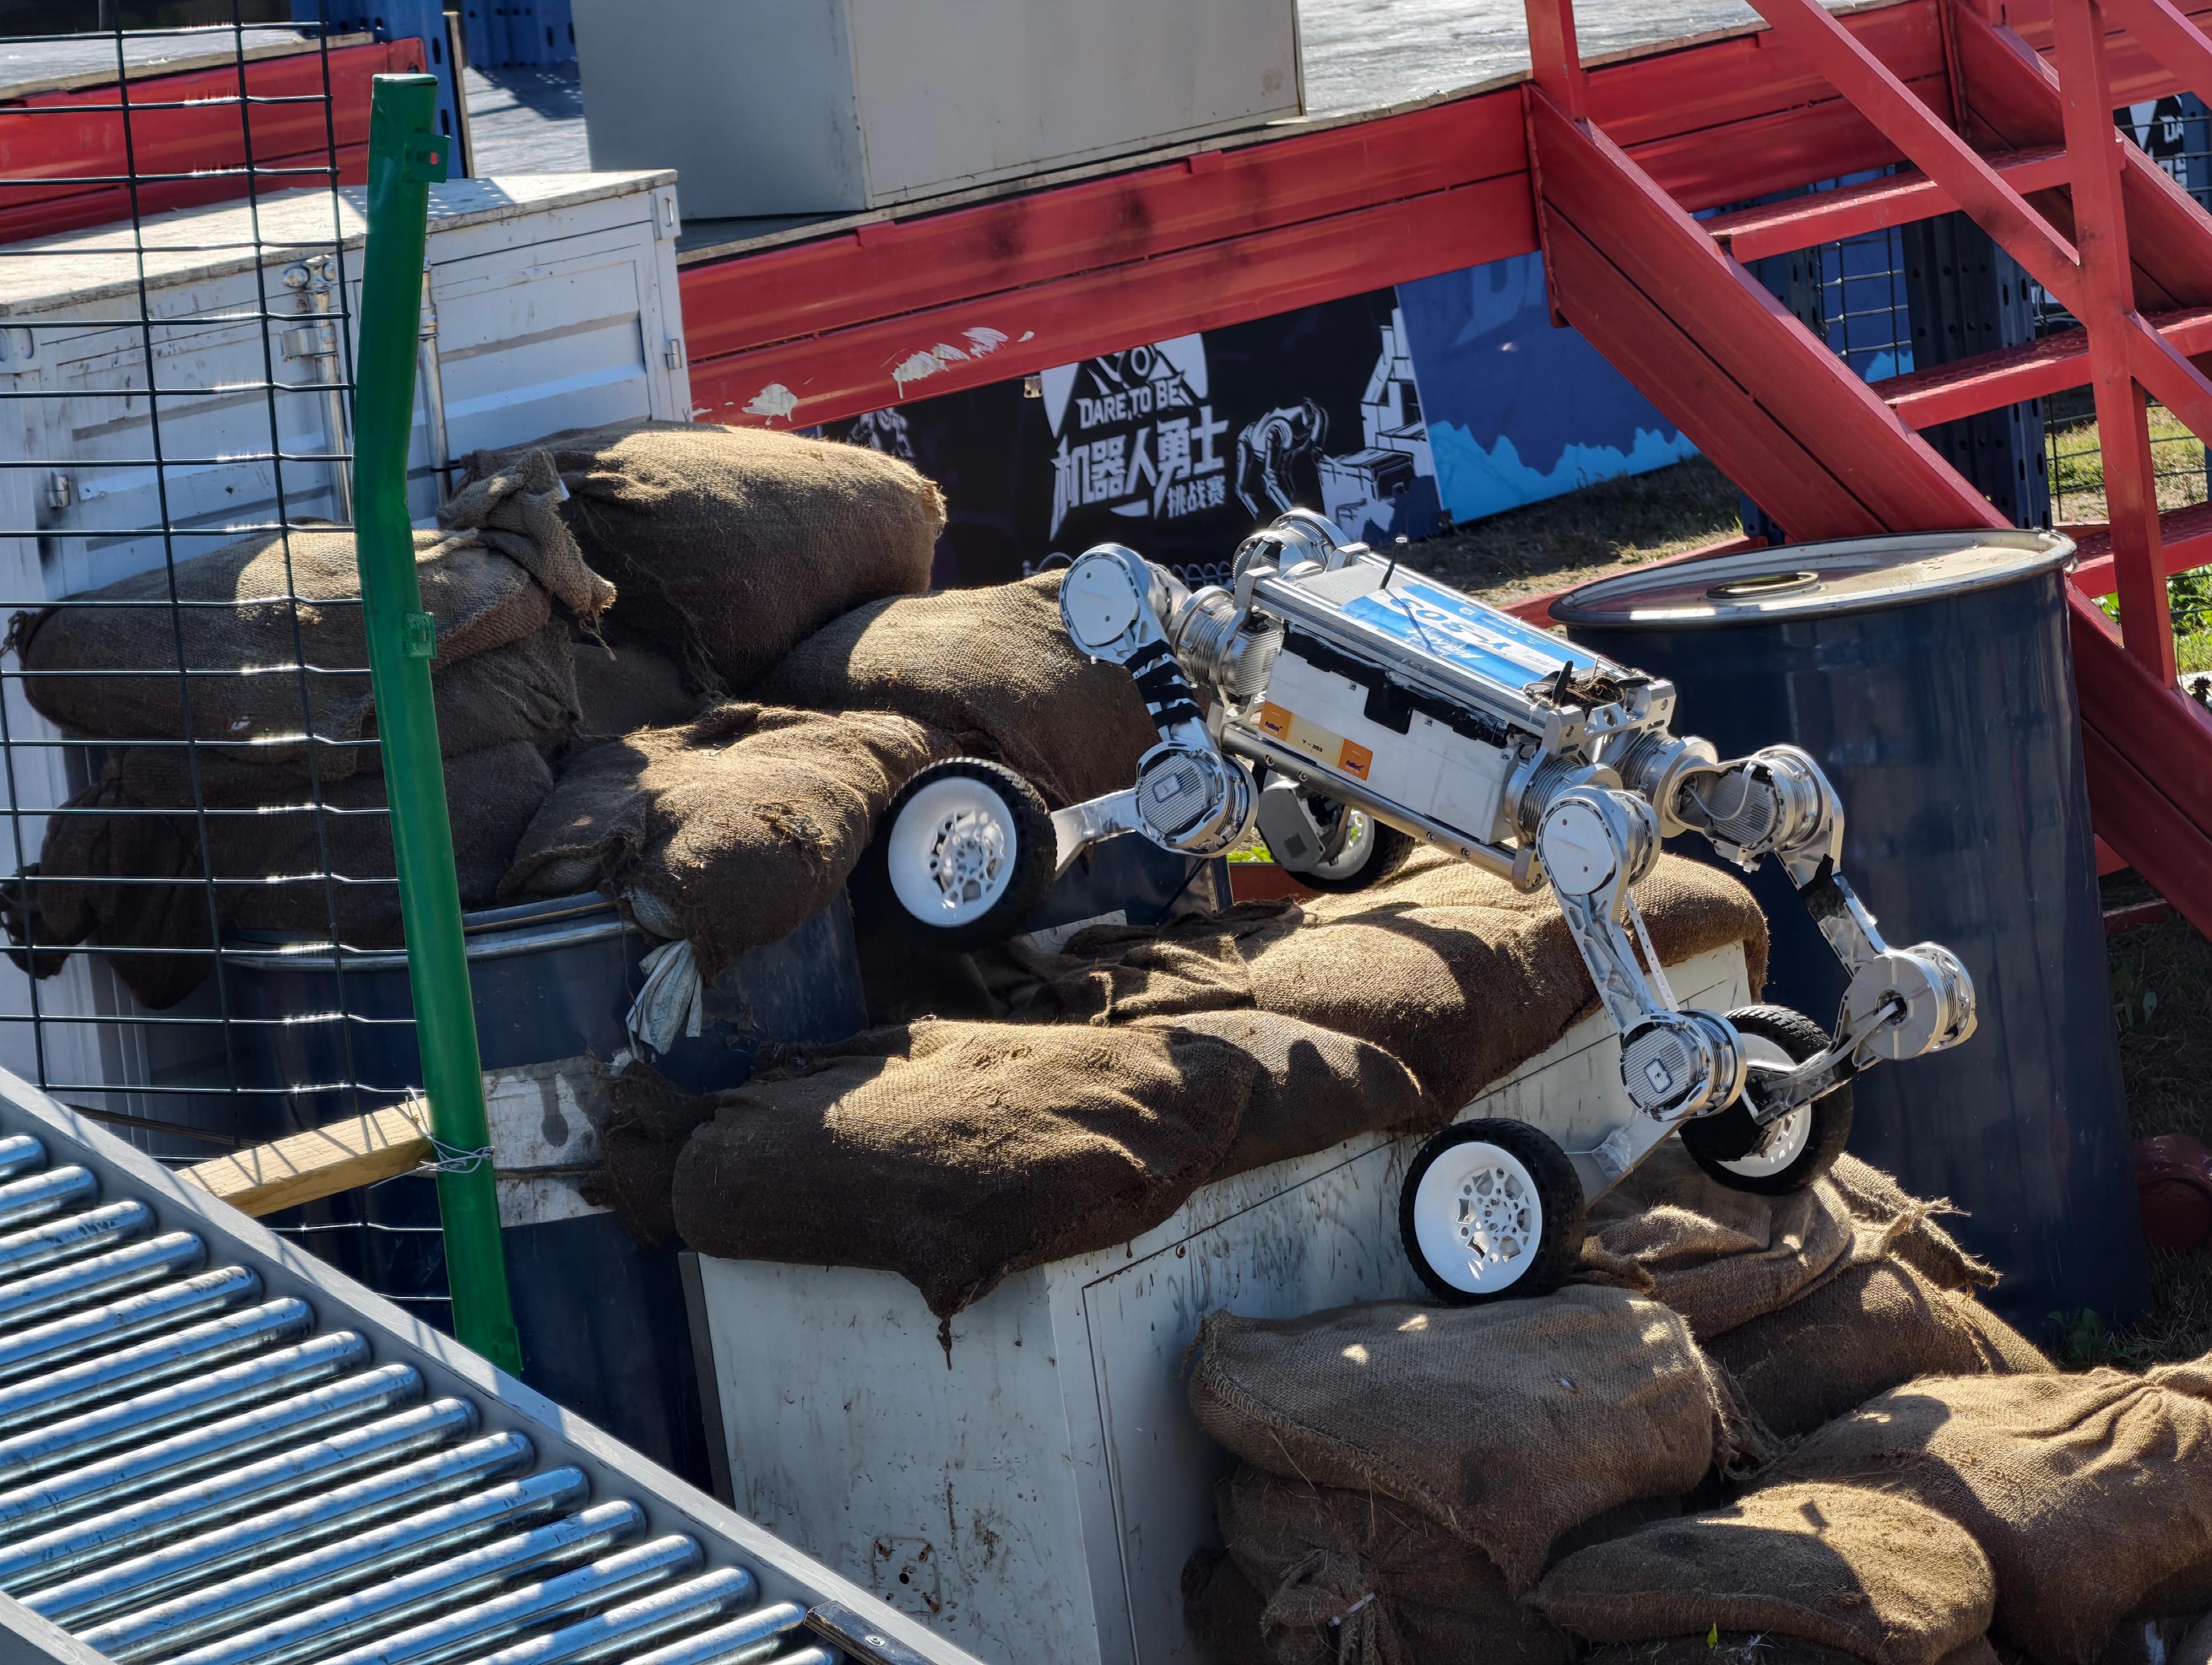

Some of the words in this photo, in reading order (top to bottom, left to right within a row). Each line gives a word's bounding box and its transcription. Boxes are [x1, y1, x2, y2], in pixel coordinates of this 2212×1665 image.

[1154, 375, 1193, 410] BE
[1049, 405, 1229, 542] 机器人勇士
[1167, 475, 1226, 519] 挑战赛
